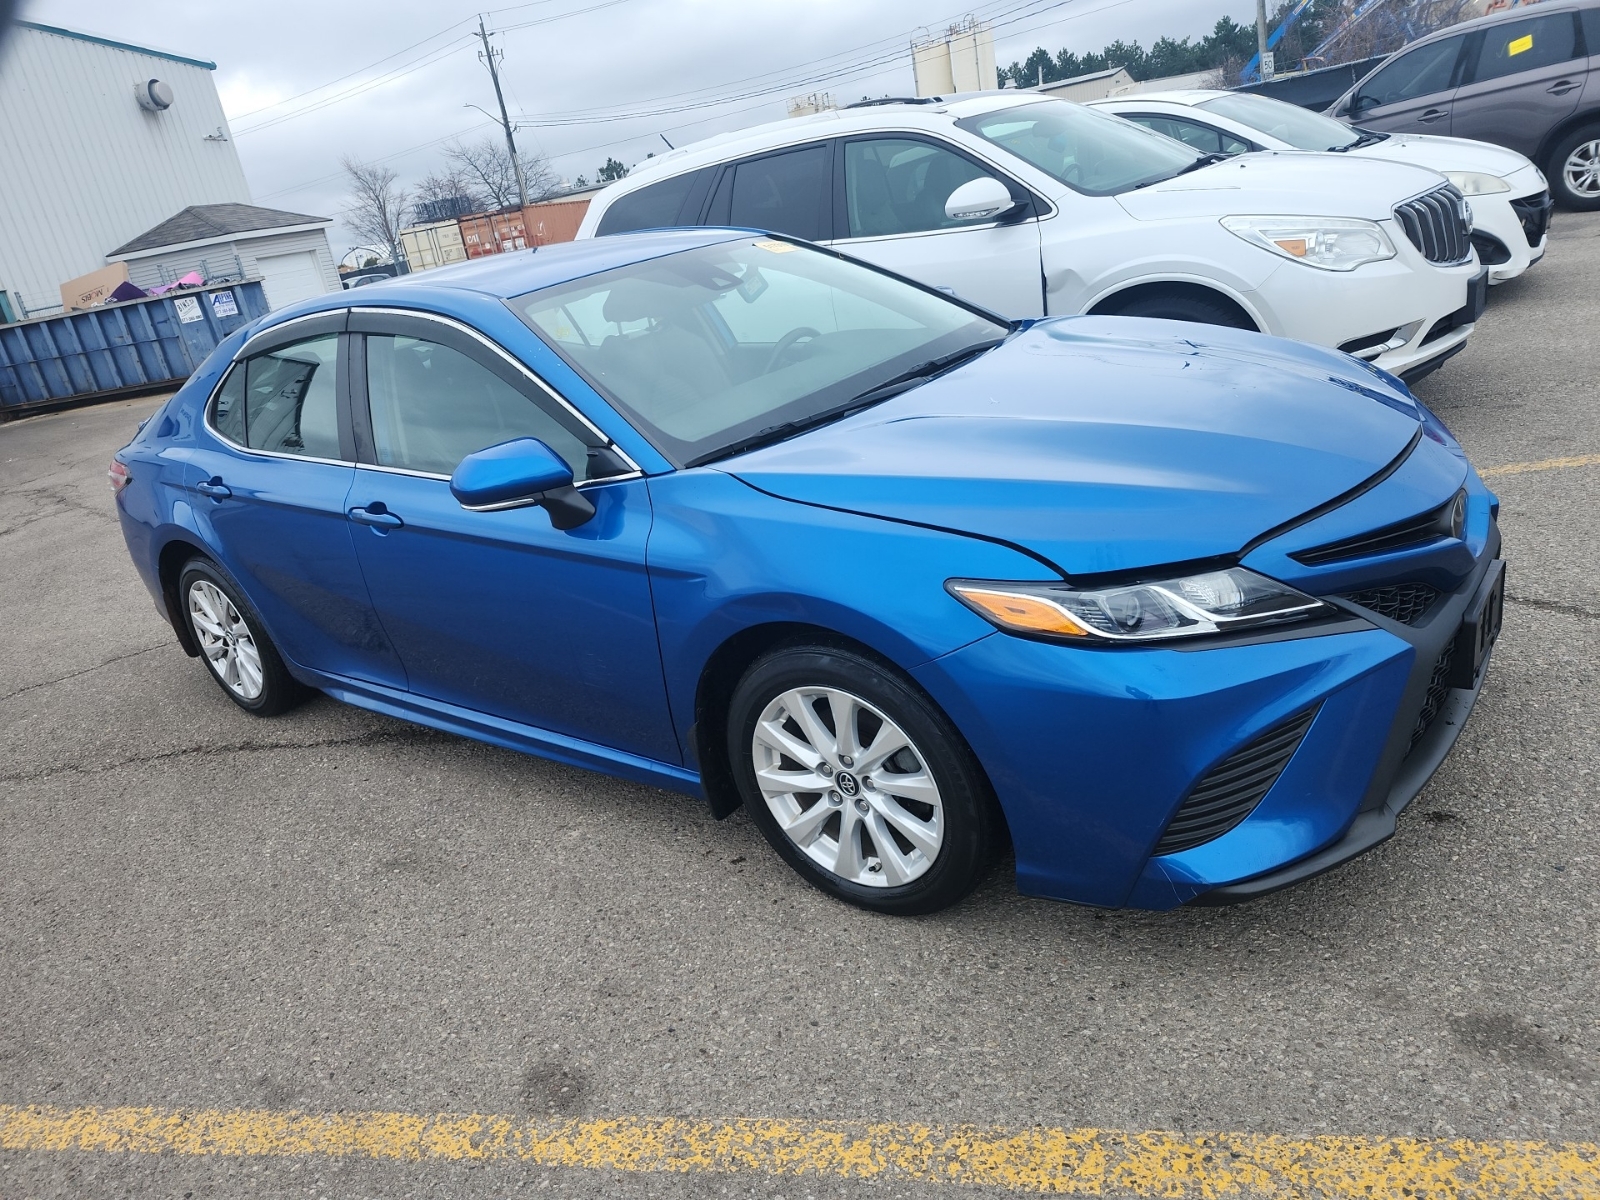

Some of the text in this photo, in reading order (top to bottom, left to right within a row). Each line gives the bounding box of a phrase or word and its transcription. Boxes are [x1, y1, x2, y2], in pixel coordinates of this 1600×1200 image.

[1264, 60, 1273, 70] 50
[81, 288, 103, 304] MOBIS
[212, 292, 232, 306] ALPINE
